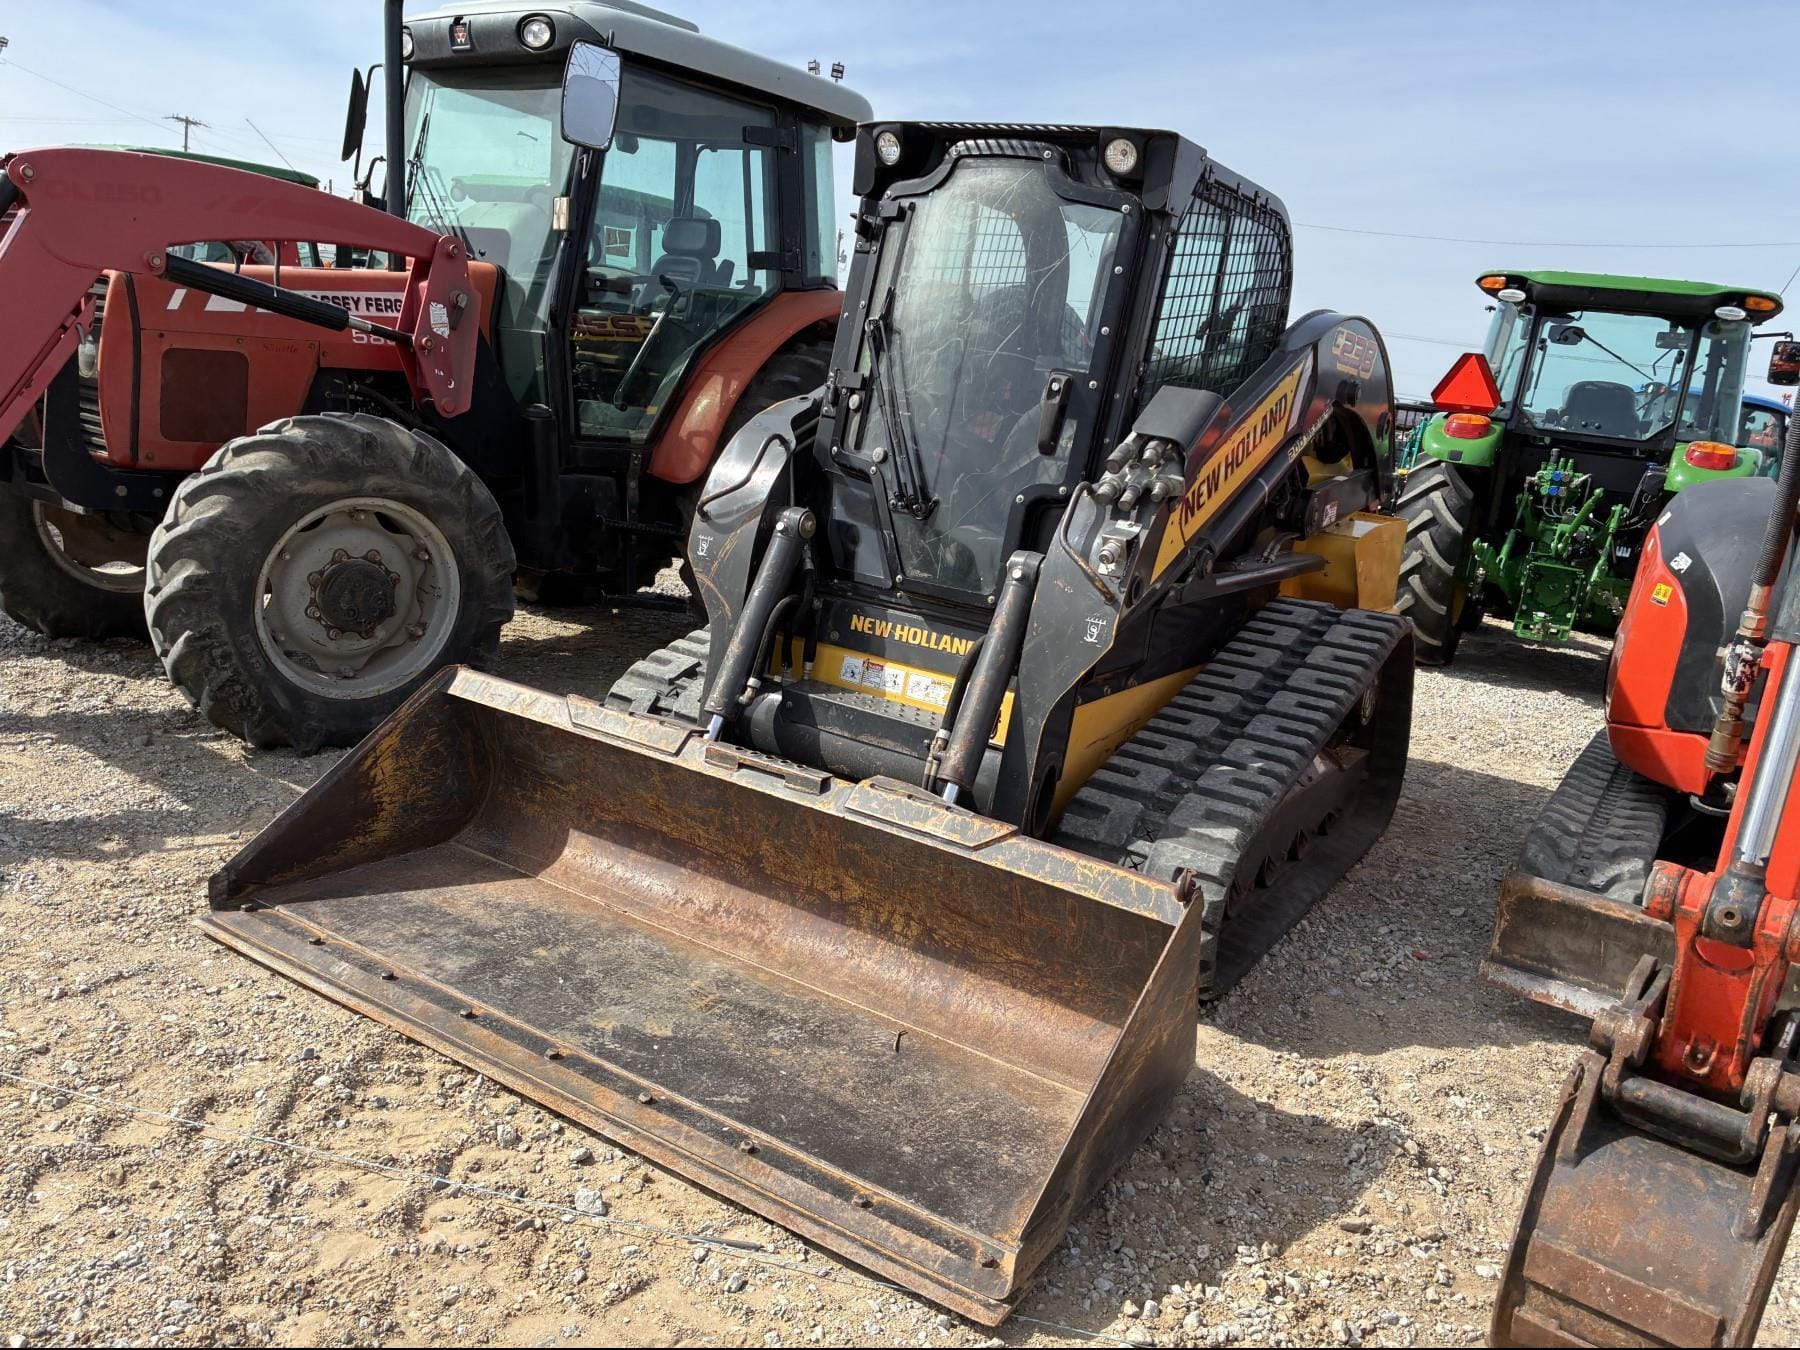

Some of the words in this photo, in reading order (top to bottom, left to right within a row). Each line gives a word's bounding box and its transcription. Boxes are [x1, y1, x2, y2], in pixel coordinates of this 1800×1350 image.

[1182, 464, 1221, 526] NEW
[1224, 393, 1288, 482] HOLLAND
[850, 614, 893, 639] NEW
